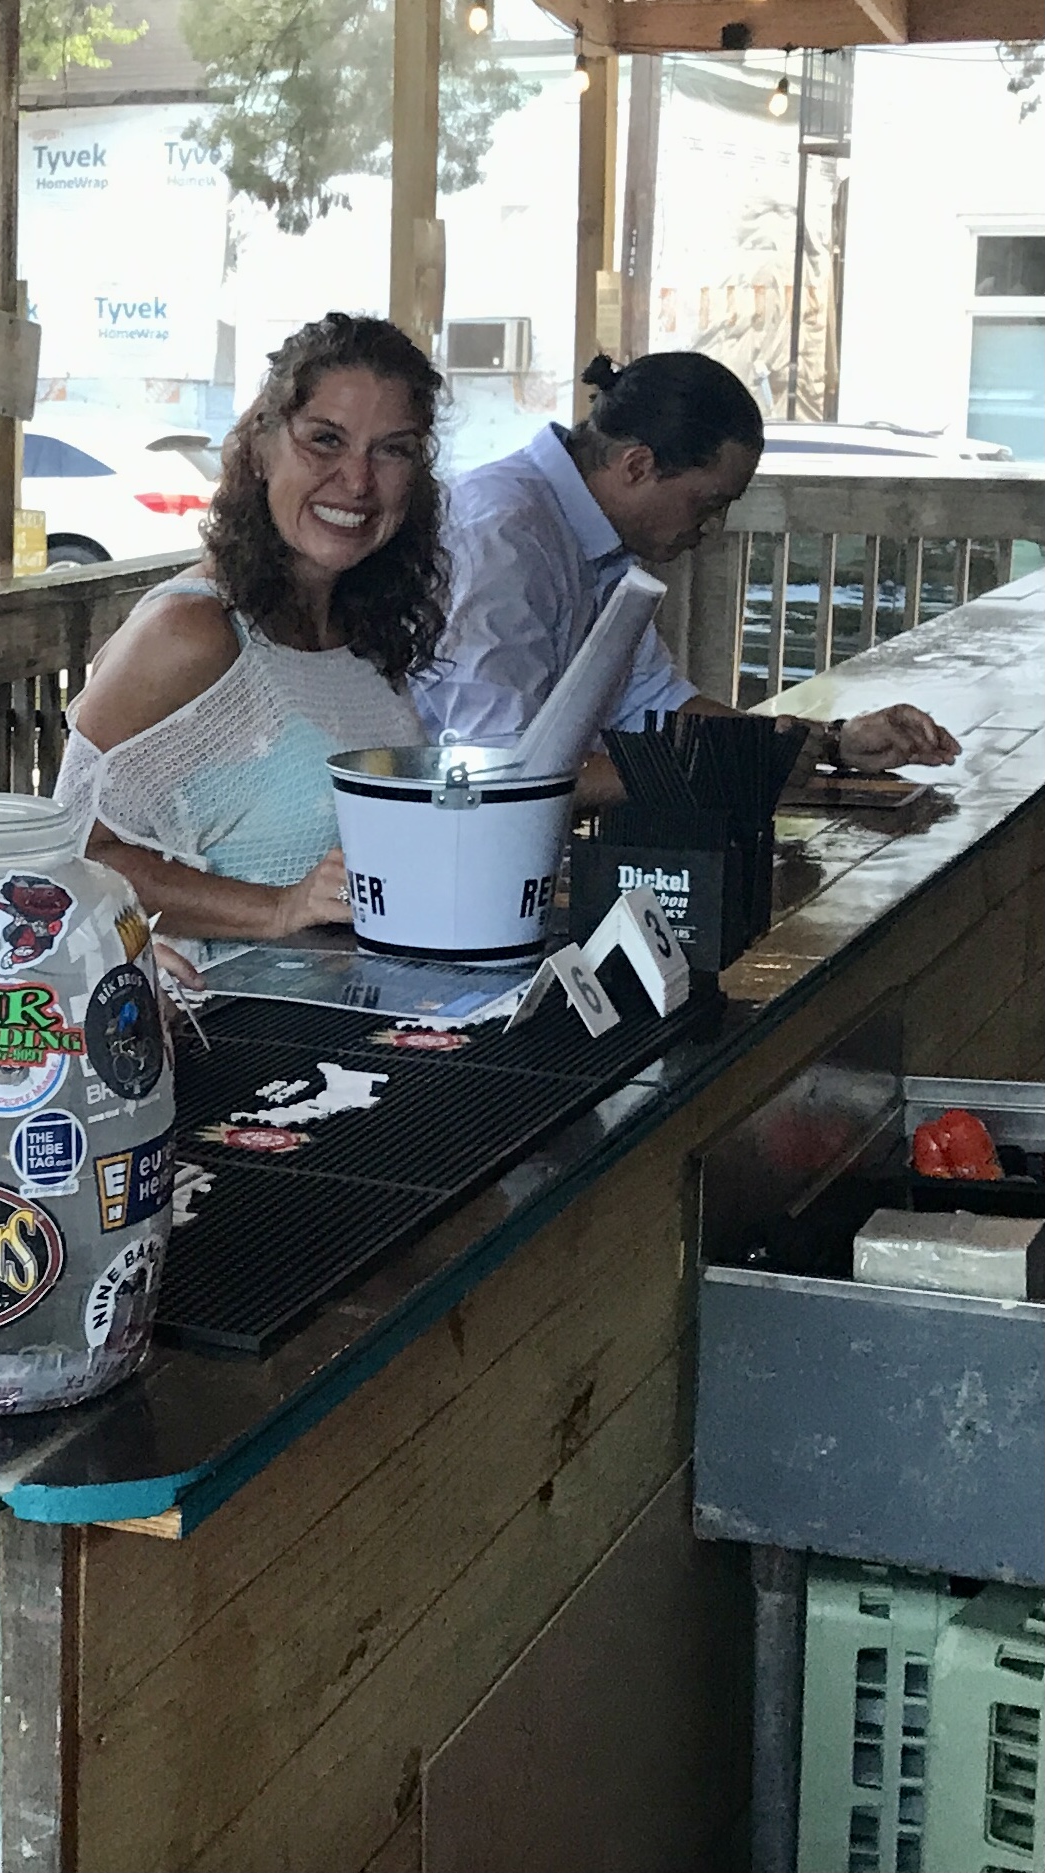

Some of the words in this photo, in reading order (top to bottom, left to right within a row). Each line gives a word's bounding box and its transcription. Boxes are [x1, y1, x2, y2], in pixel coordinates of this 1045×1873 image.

[33, 143, 107, 175] Tyvek
[36, 177, 109, 190] HomeWrap
[94, 296, 168, 325] Tyvek
[98, 328, 170, 341] HomeWrap
[617, 865, 691, 893] Dickel
[644, 908, 673, 958] 3
[570, 965, 603, 1015] 6
[27, 1131, 55, 1145] THE
[27, 1142, 64, 1157] TUBE
[91, 1266, 121, 1331] NINE
